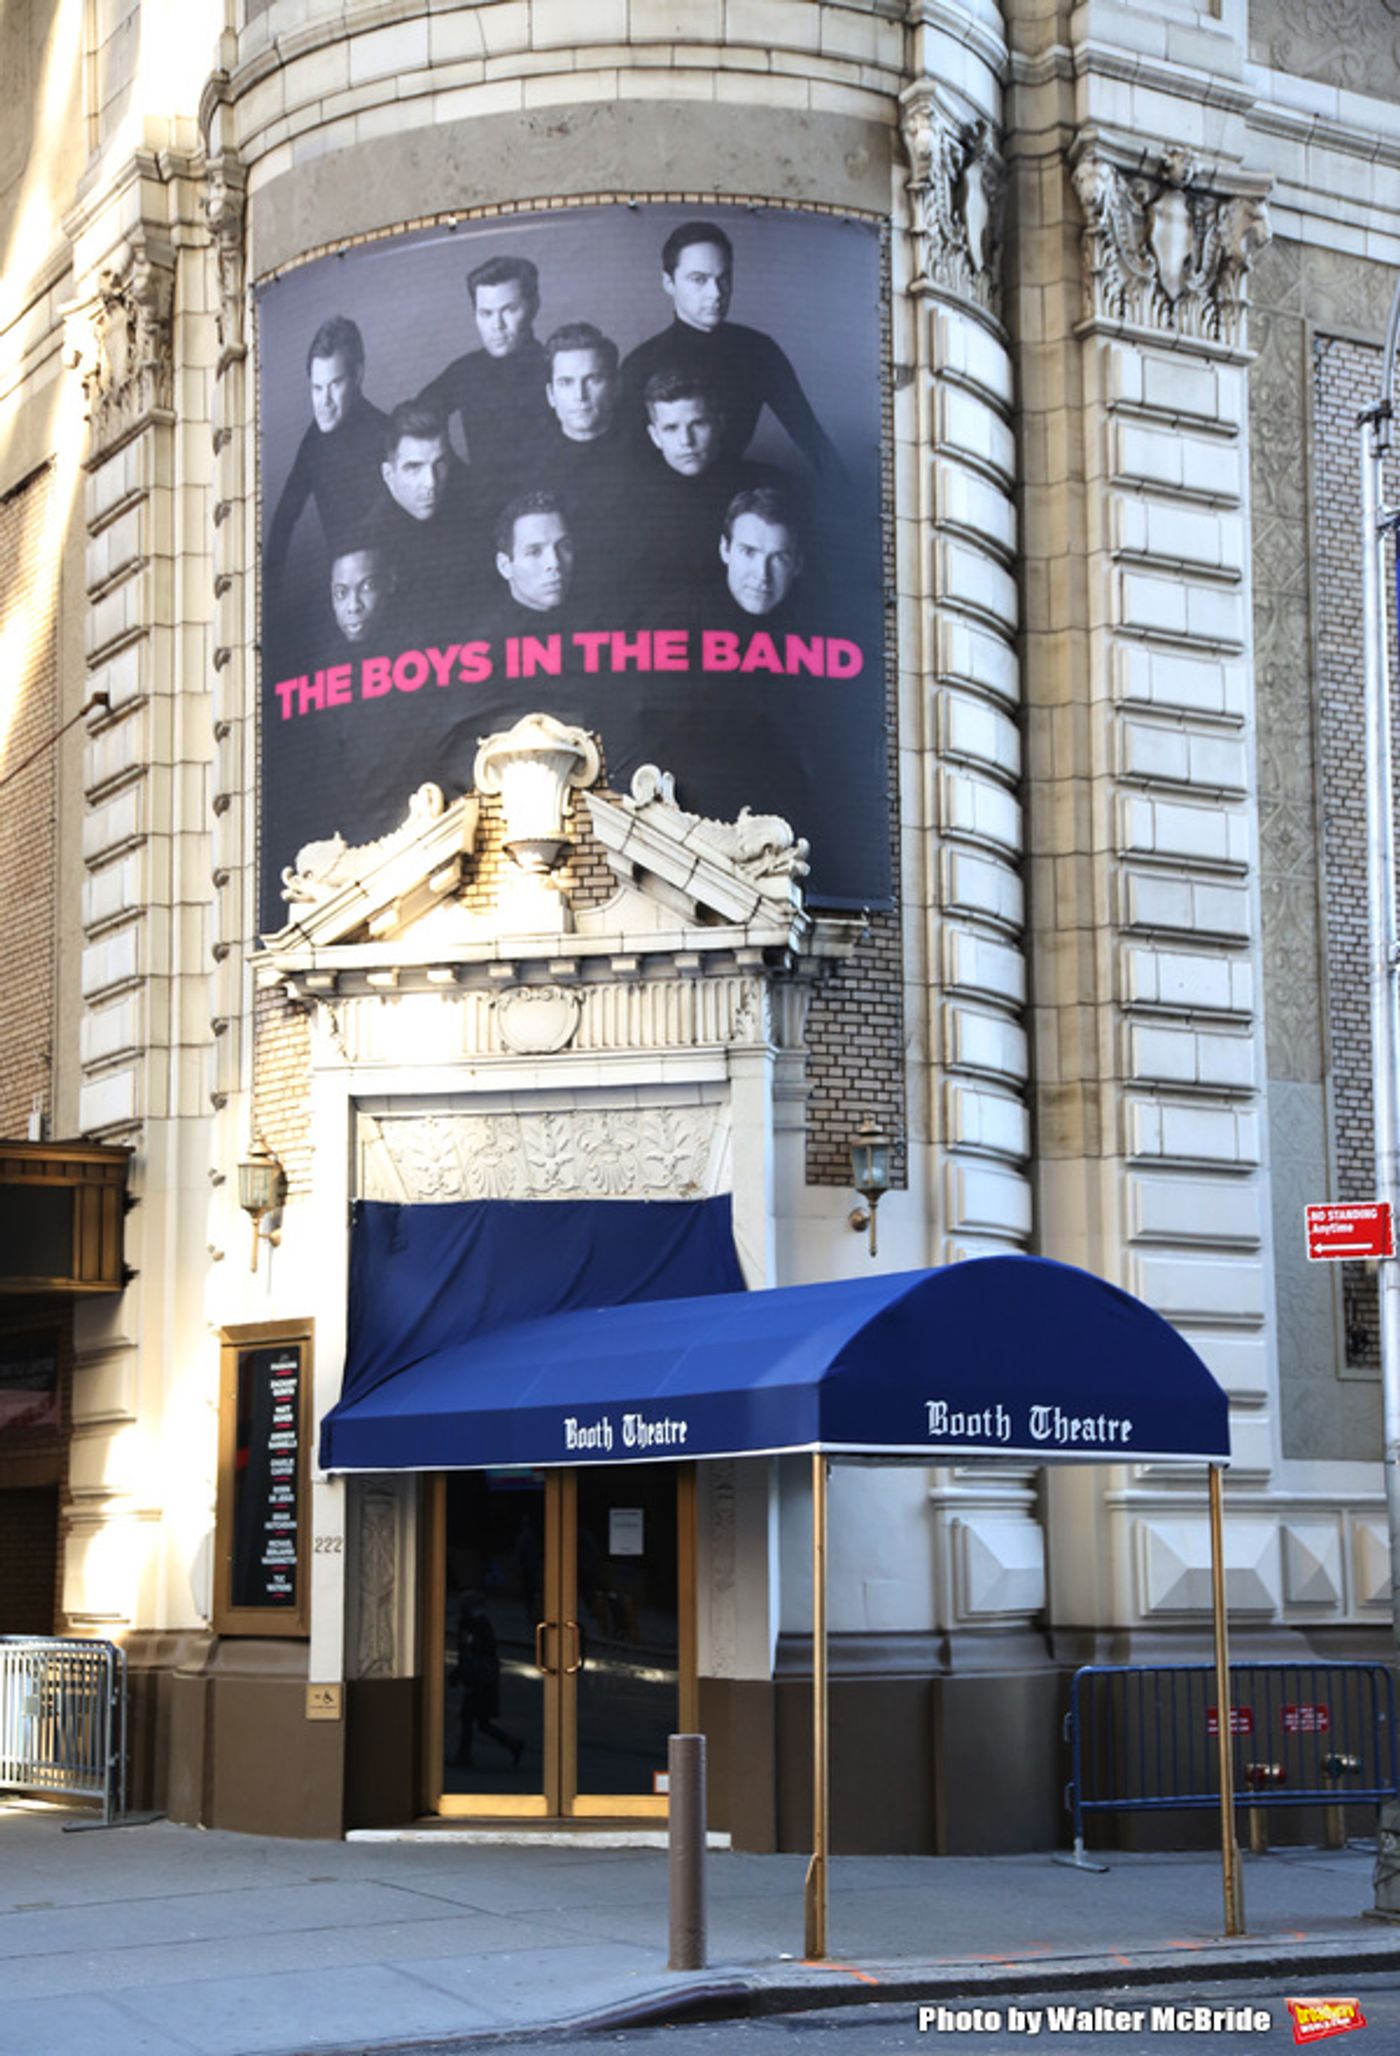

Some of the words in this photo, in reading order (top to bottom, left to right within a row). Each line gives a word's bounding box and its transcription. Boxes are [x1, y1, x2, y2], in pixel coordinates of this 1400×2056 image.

[275, 662, 353, 721] THE
[361, 641, 494, 698] BOYS
[506, 634, 562, 679] IN
[573, 630, 689, 673] THE
[702, 630, 864, 679] BAND
[1311, 1210, 1327, 1222] NO
[1327, 1207, 1378, 1222] STANDING
[563, 1416, 613, 1452] Booth
[622, 1413, 688, 1449] Theatre
[924, 1400, 1012, 1443] Booth
[1028, 1405, 1133, 1444] Theatre
[314, 1535, 342, 1553] 222
